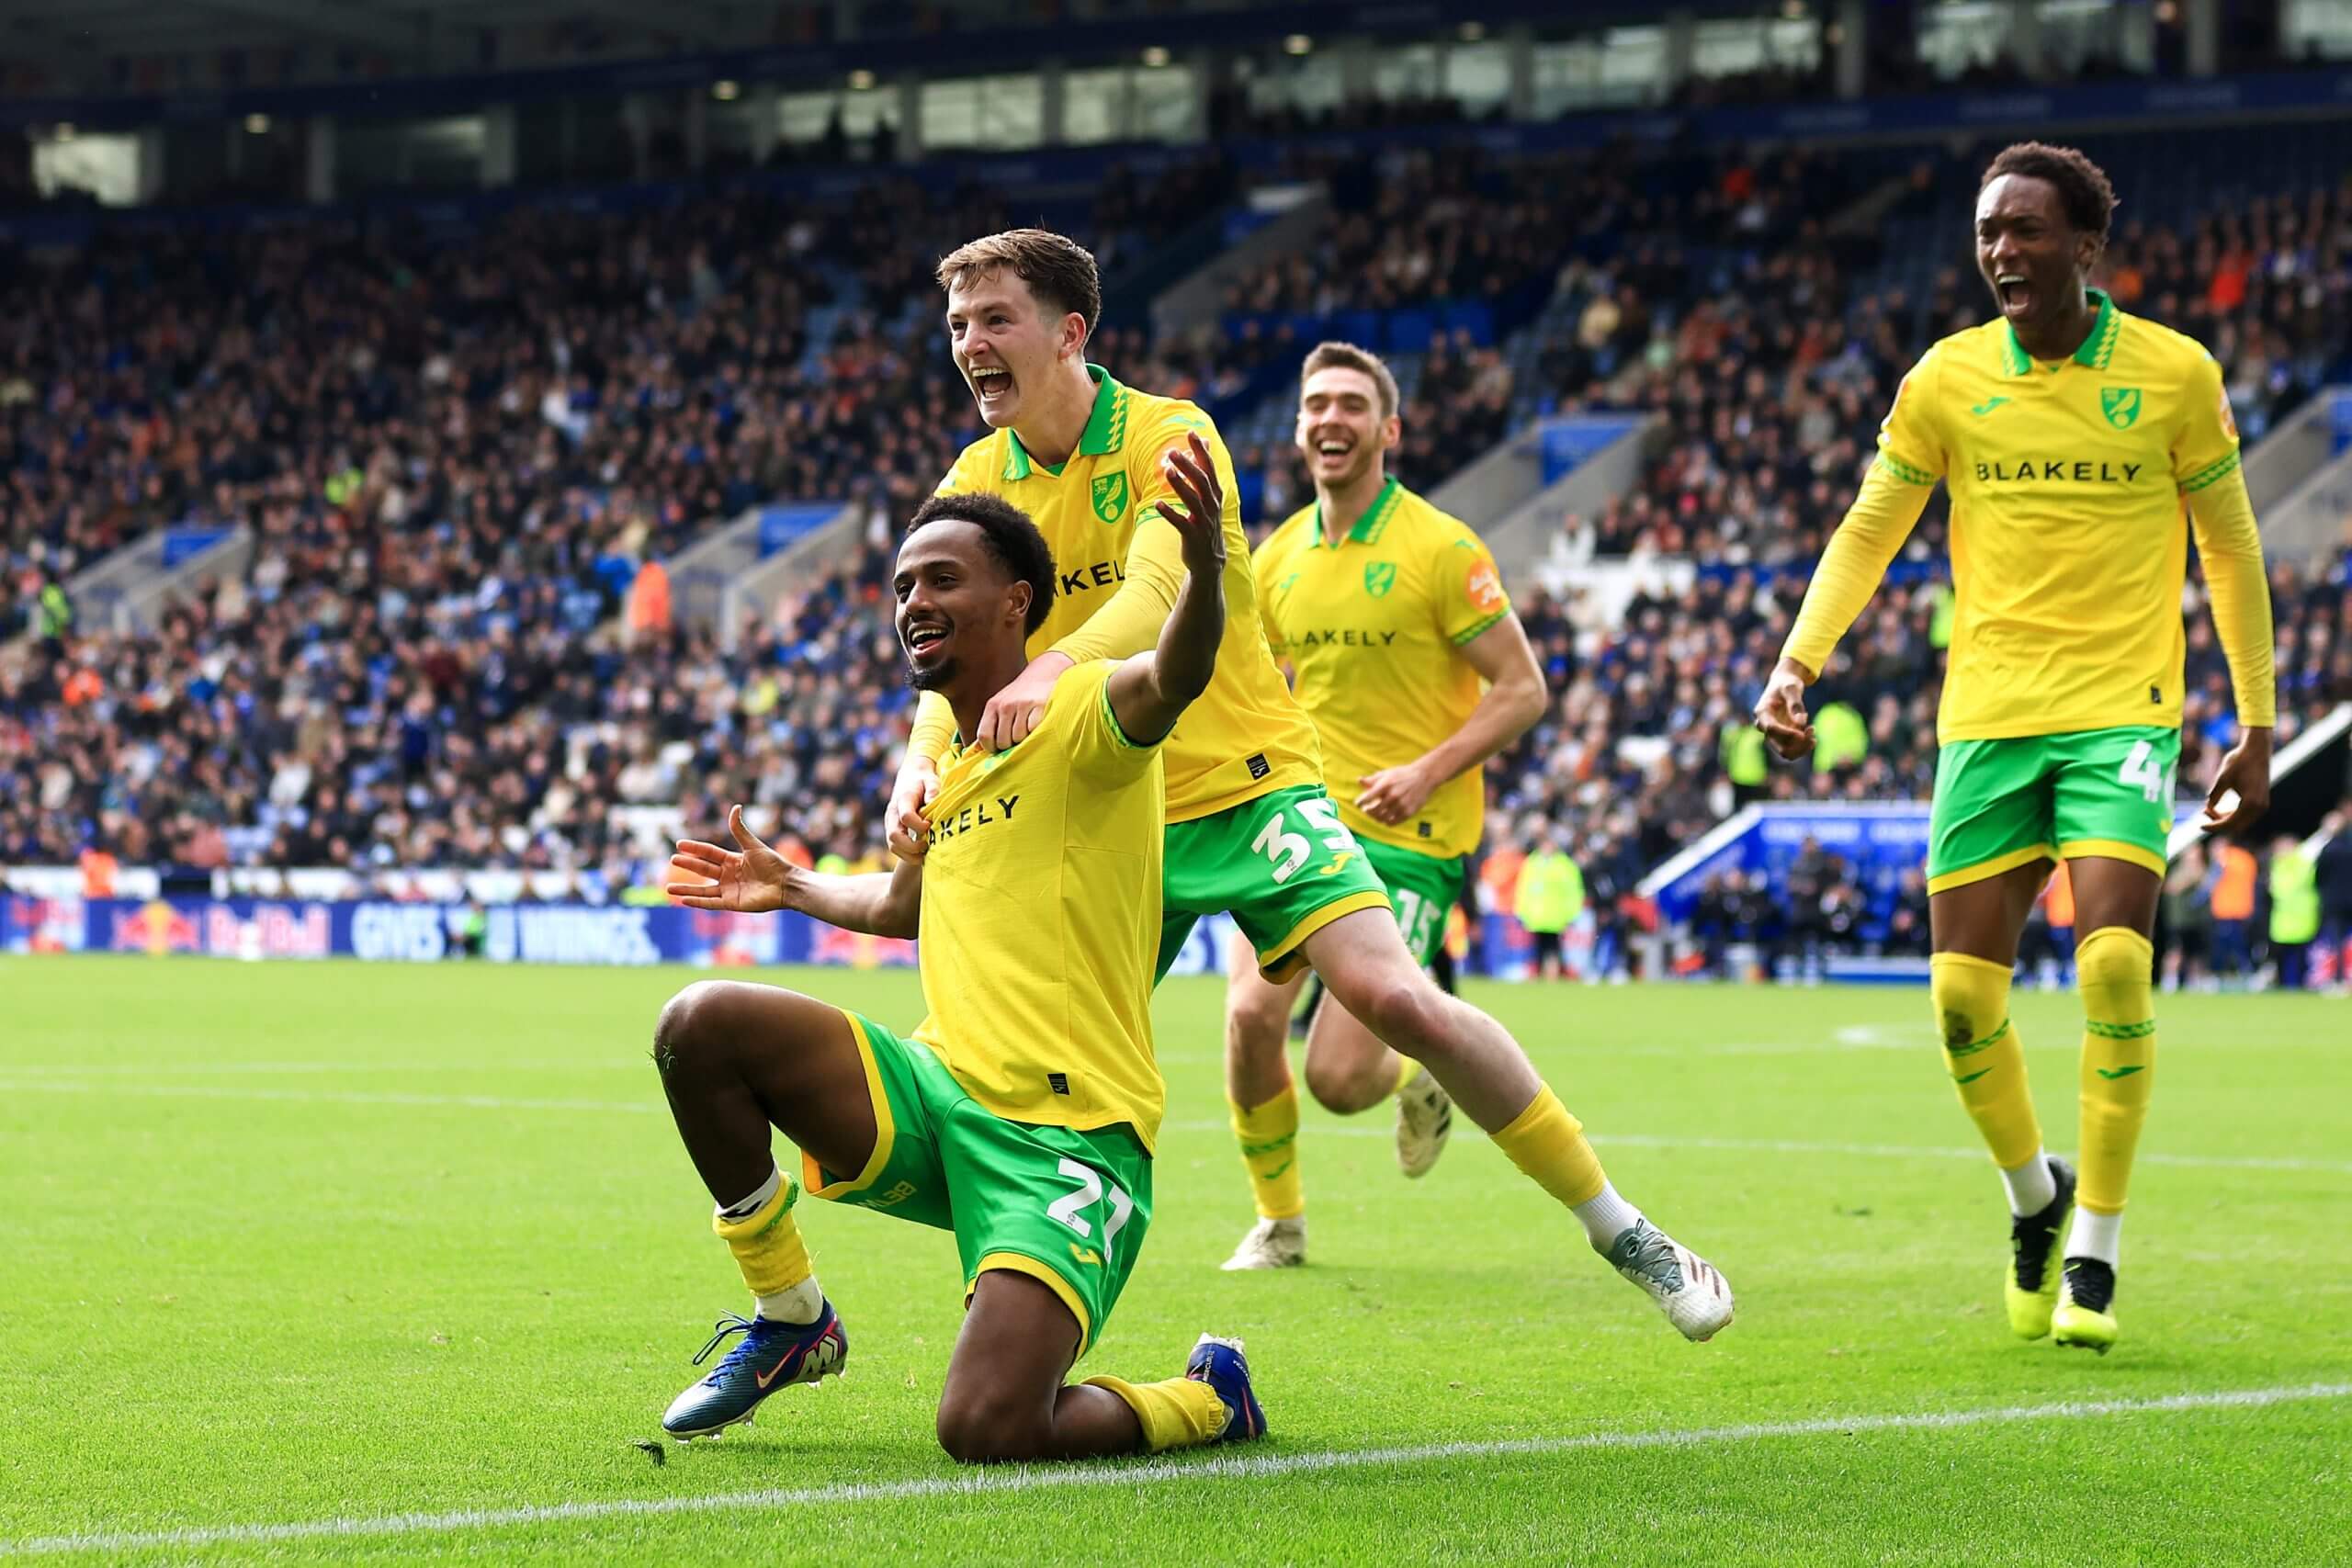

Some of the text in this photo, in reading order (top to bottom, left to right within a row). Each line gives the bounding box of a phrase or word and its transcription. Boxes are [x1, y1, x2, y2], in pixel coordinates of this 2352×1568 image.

[1976, 462, 2142, 481] BLAKELY
[1250, 798, 1358, 885] 35
[1396, 887, 1441, 956] 15
